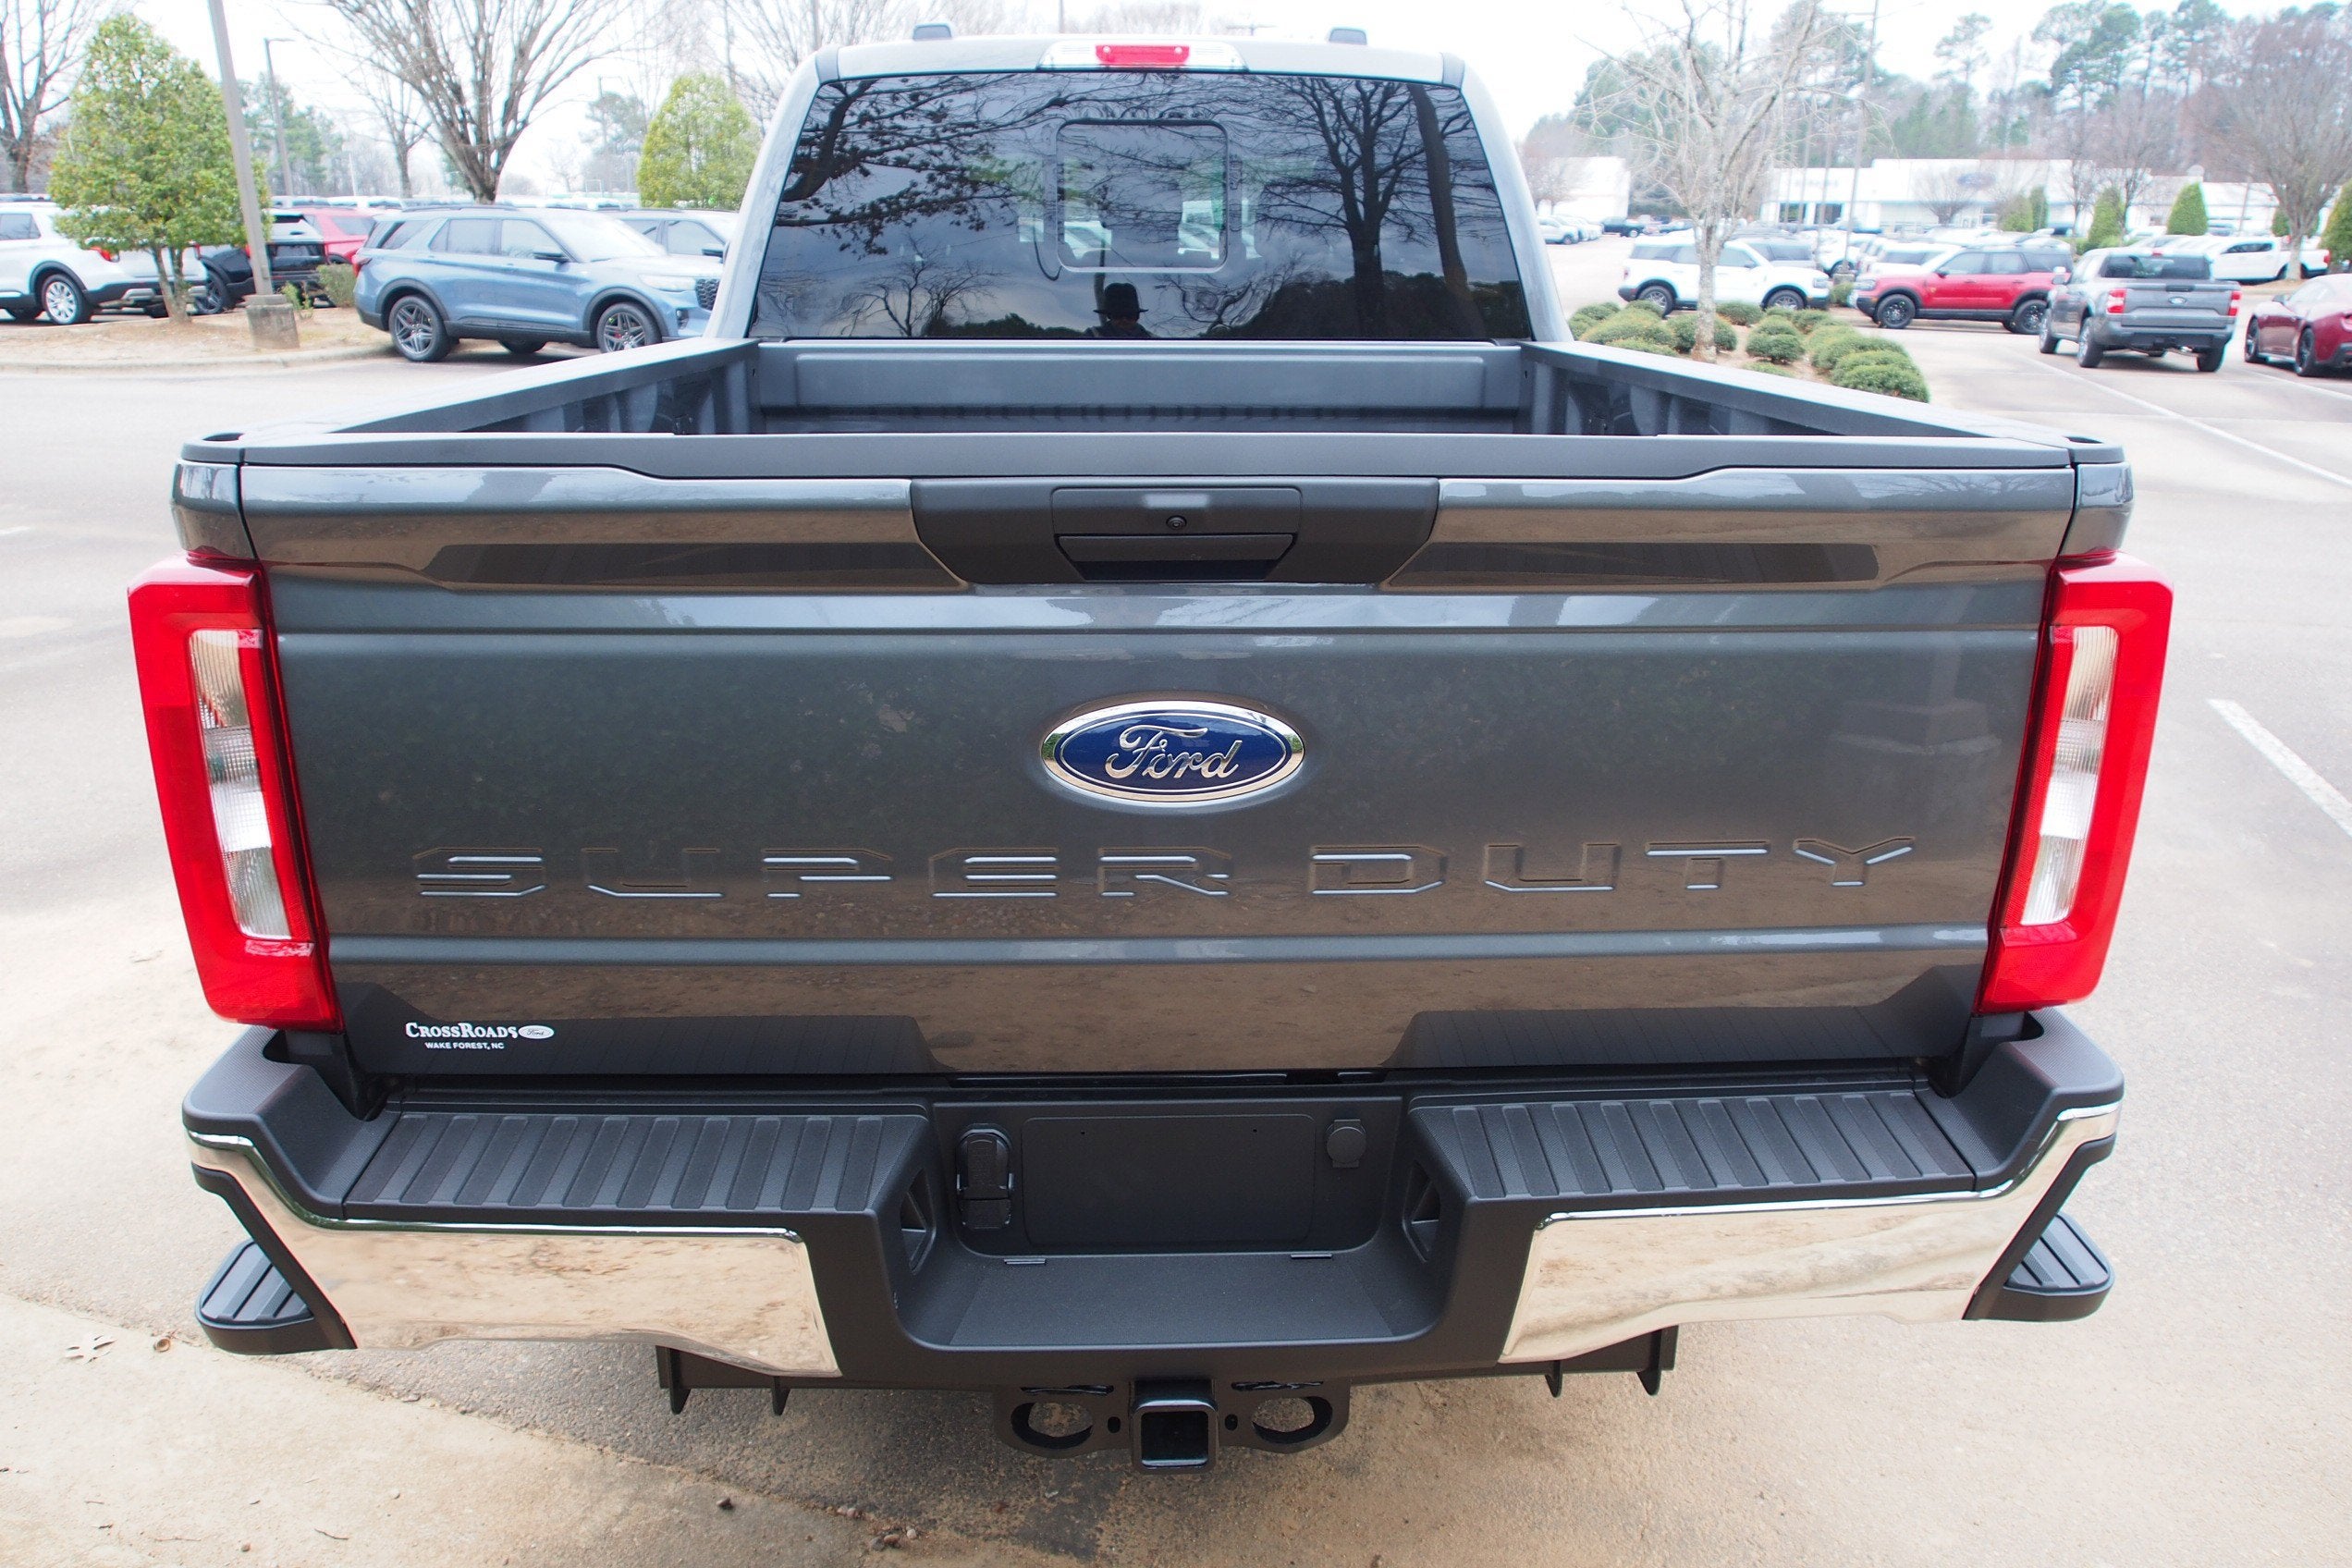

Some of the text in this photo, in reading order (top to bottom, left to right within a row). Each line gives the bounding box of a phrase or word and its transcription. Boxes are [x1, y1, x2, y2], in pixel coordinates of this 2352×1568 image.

[1105, 725, 1243, 778] Ford
[412, 838, 1917, 899] SUPER DUTY
[453, 1042, 490, 1050] FOREST,
